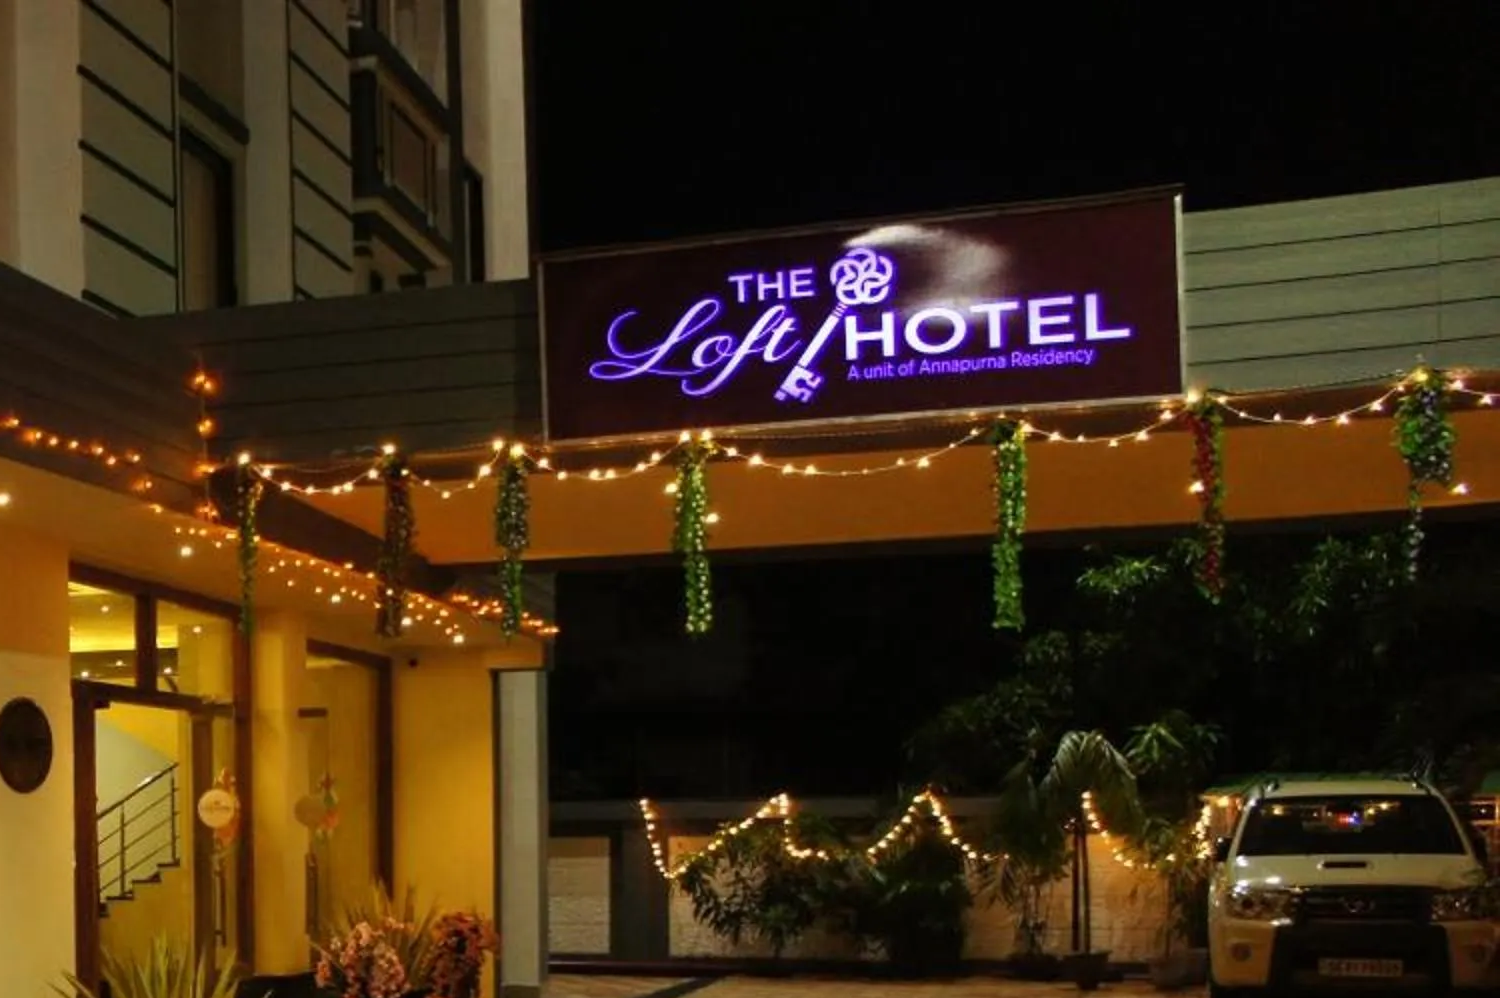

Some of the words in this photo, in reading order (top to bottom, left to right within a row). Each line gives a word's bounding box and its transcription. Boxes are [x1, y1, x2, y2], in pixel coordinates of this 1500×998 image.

[727, 267, 816, 303] THE
[588, 298, 802, 396] Loft
[844, 293, 1132, 361] HOTEL
[847, 365, 860, 380] A
[863, 361, 895, 379] unit
[897, 358, 916, 377] of
[918, 353, 1007, 375] Annapurna
[1010, 347, 1095, 367] Residency
